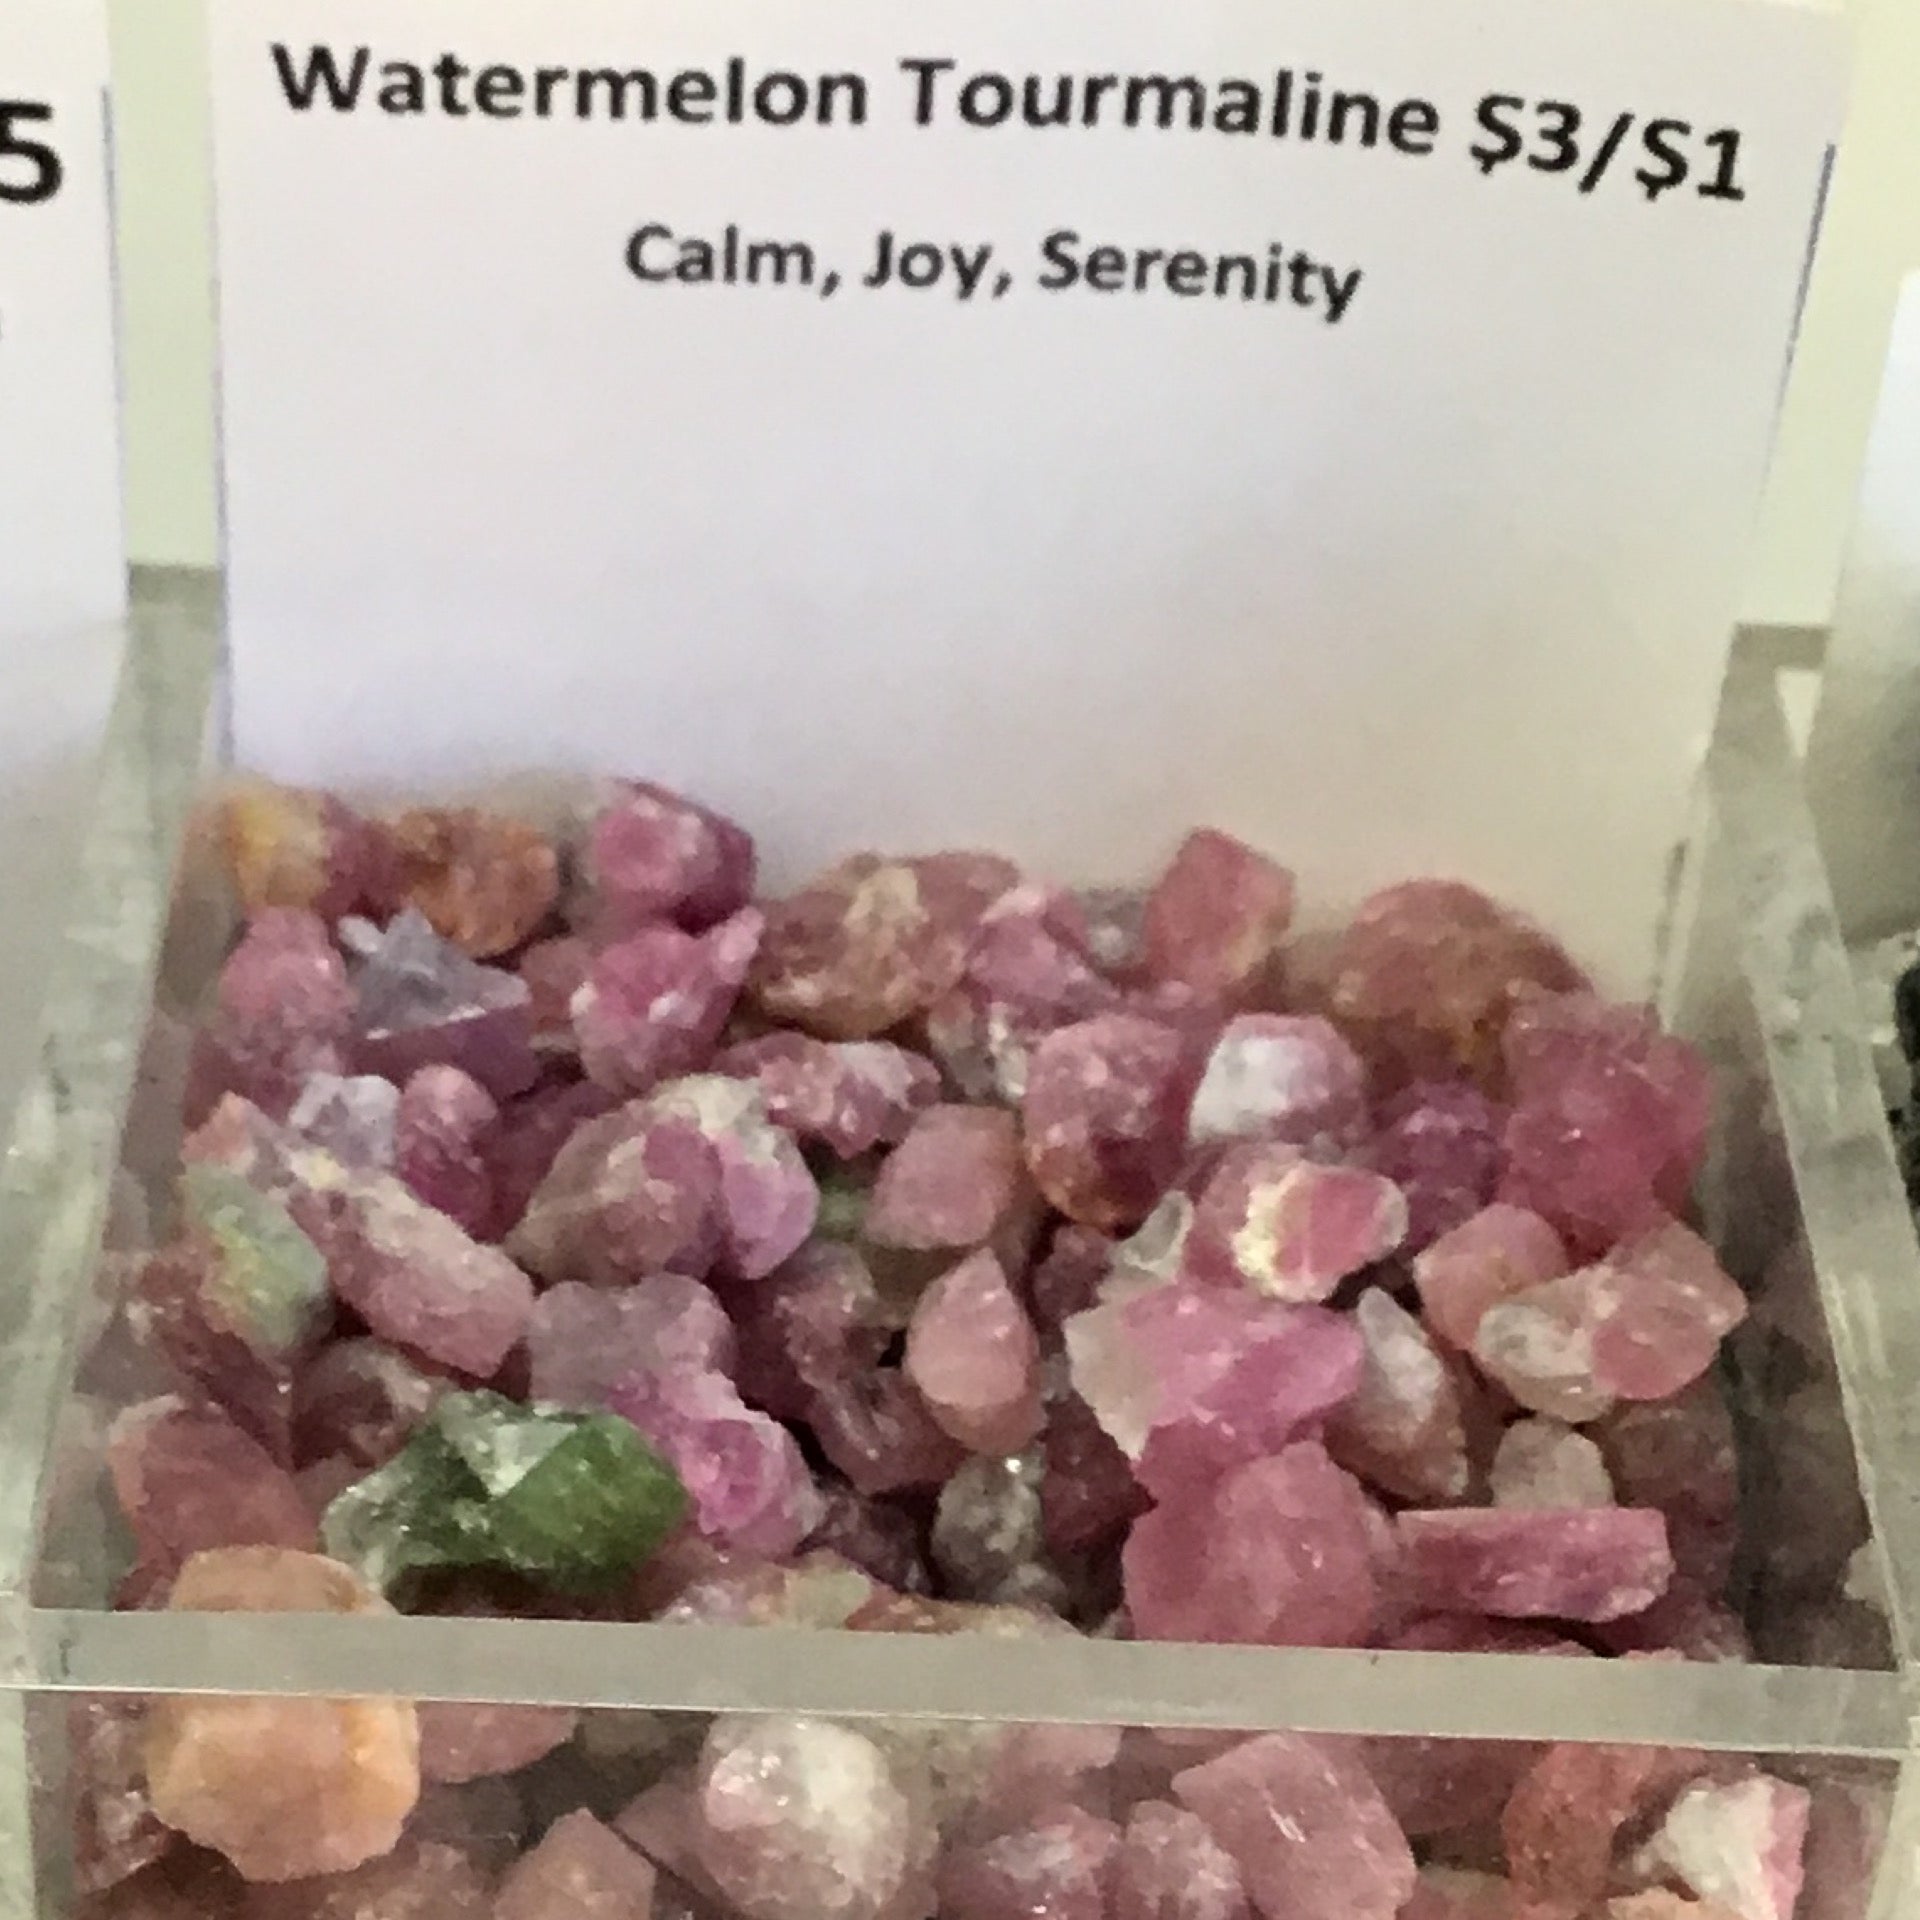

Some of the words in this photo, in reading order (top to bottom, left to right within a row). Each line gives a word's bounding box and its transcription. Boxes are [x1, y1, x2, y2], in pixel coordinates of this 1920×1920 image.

[270, 43, 867, 126] Watermelon
[899, 58, 1440, 155] Tourmaline
[1469, 93, 1746, 202] $3/$1
[625, 224, 839, 297] Calm,
[864, 231, 1012, 301] Joy,
[1038, 230, 1363, 324] Serenity
